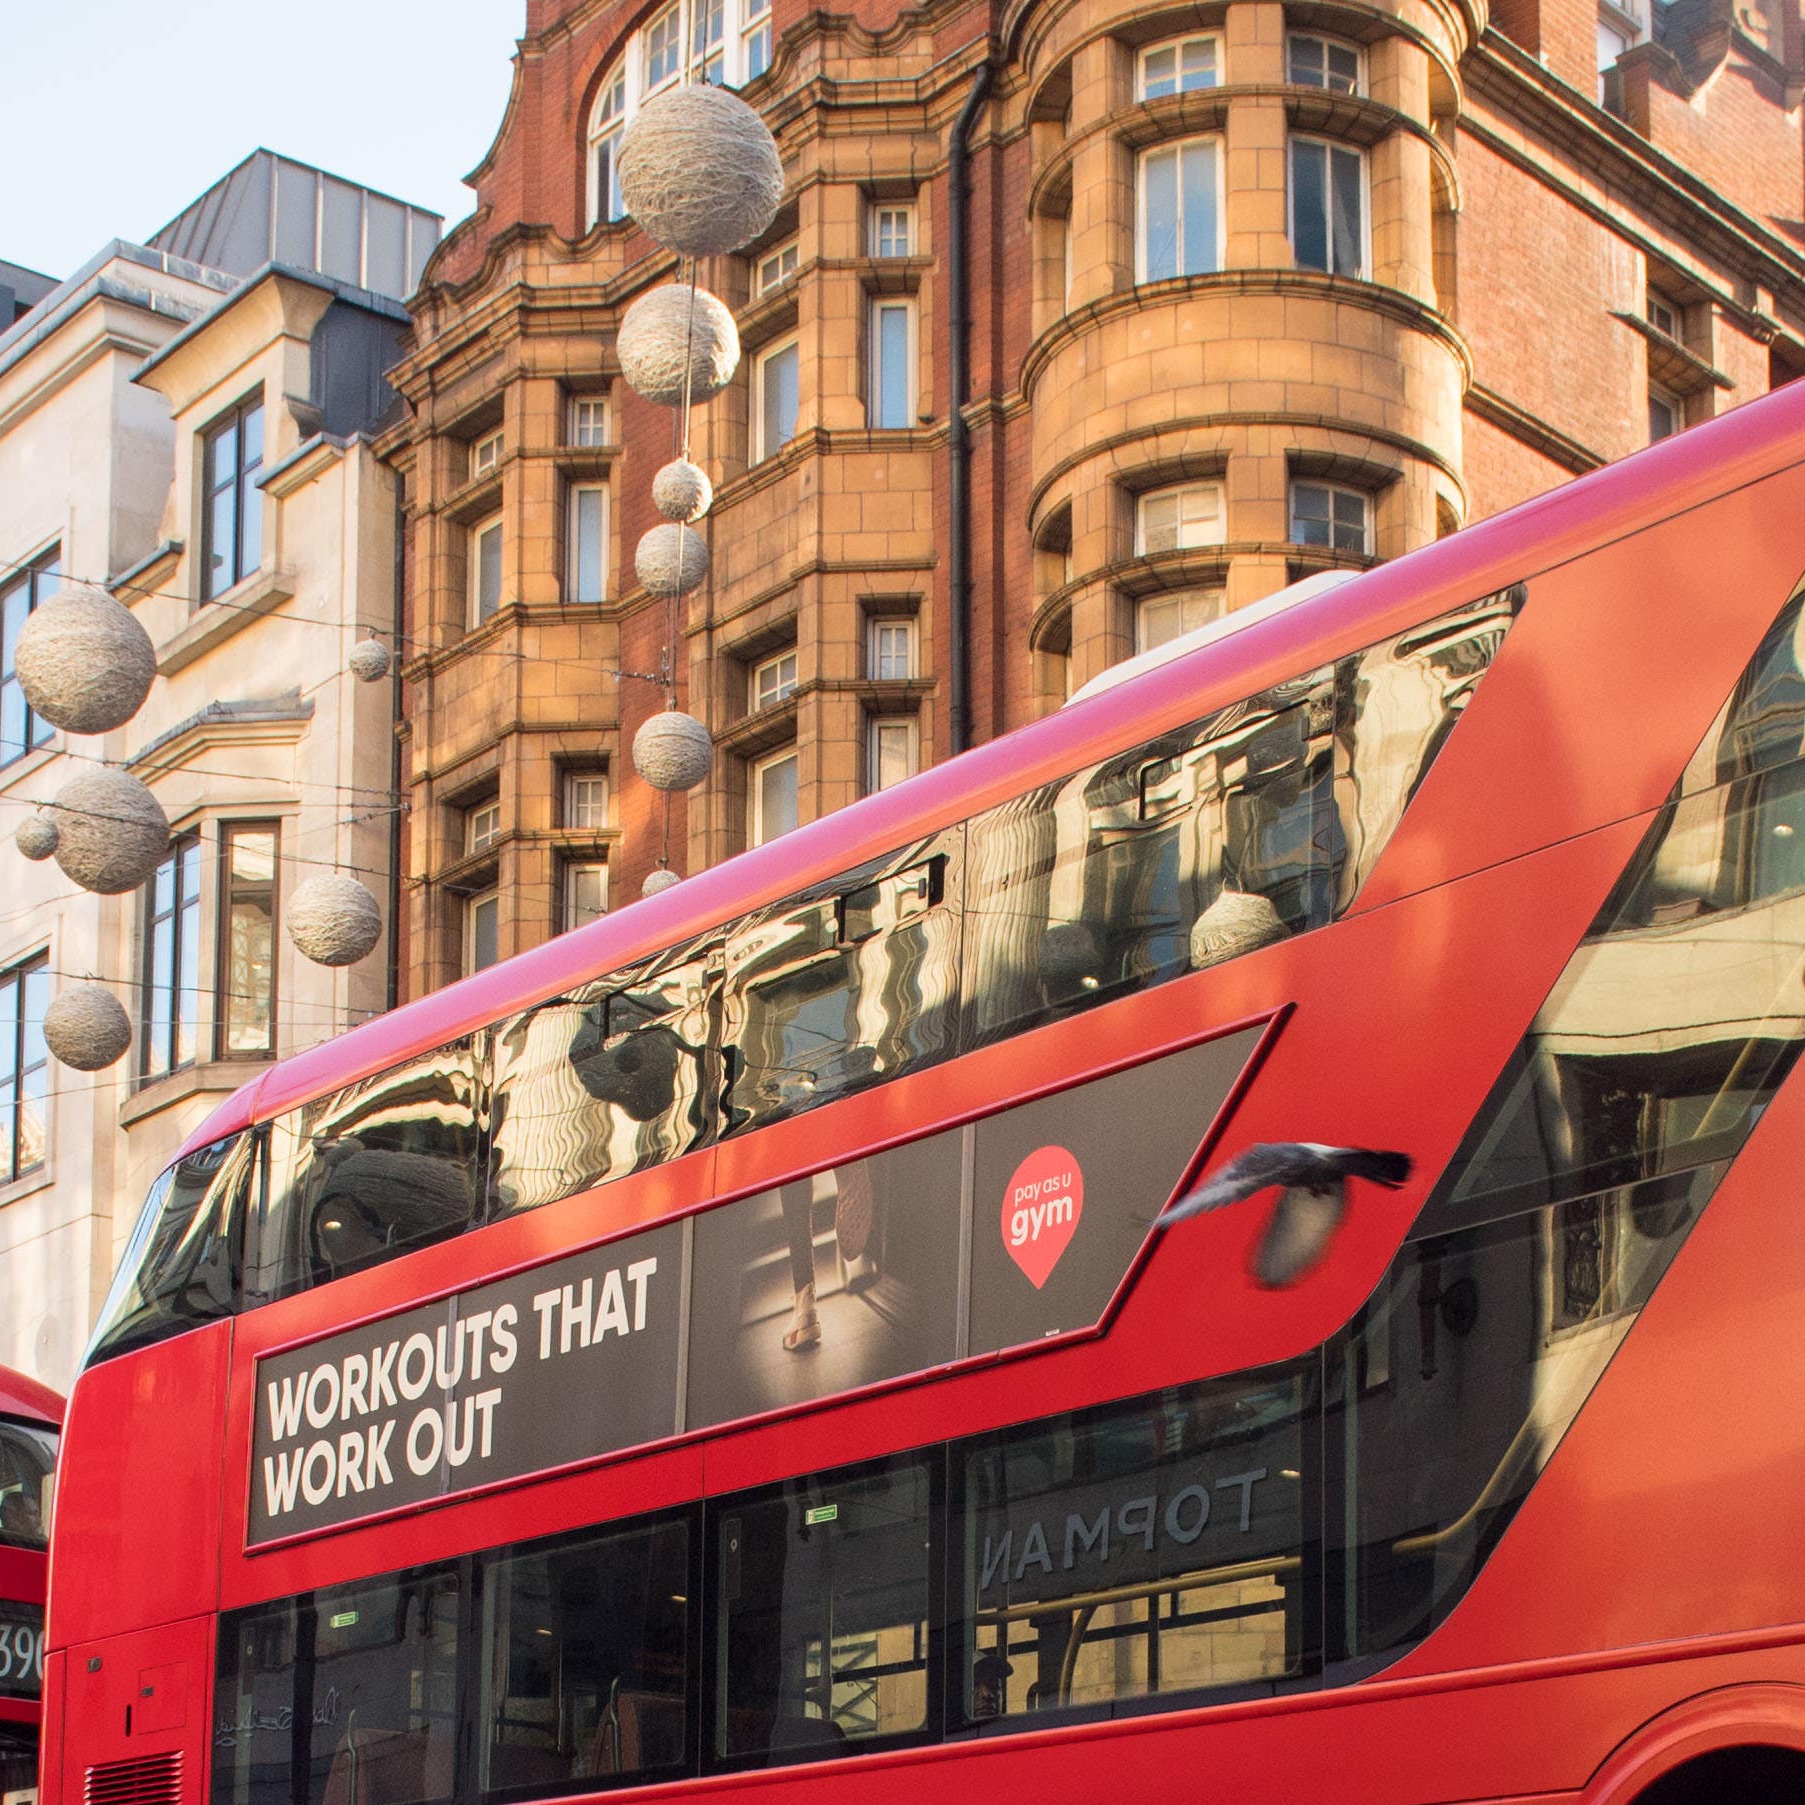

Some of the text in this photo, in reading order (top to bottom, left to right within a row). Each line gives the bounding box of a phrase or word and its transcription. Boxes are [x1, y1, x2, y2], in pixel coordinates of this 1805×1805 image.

[1010, 1195, 1074, 1246] gym
[1014, 1172, 1072, 1208] pay as u
[267, 1257, 657, 1442] WORKOUTS THAT
[263, 1387, 502, 1517] WORK OUT
